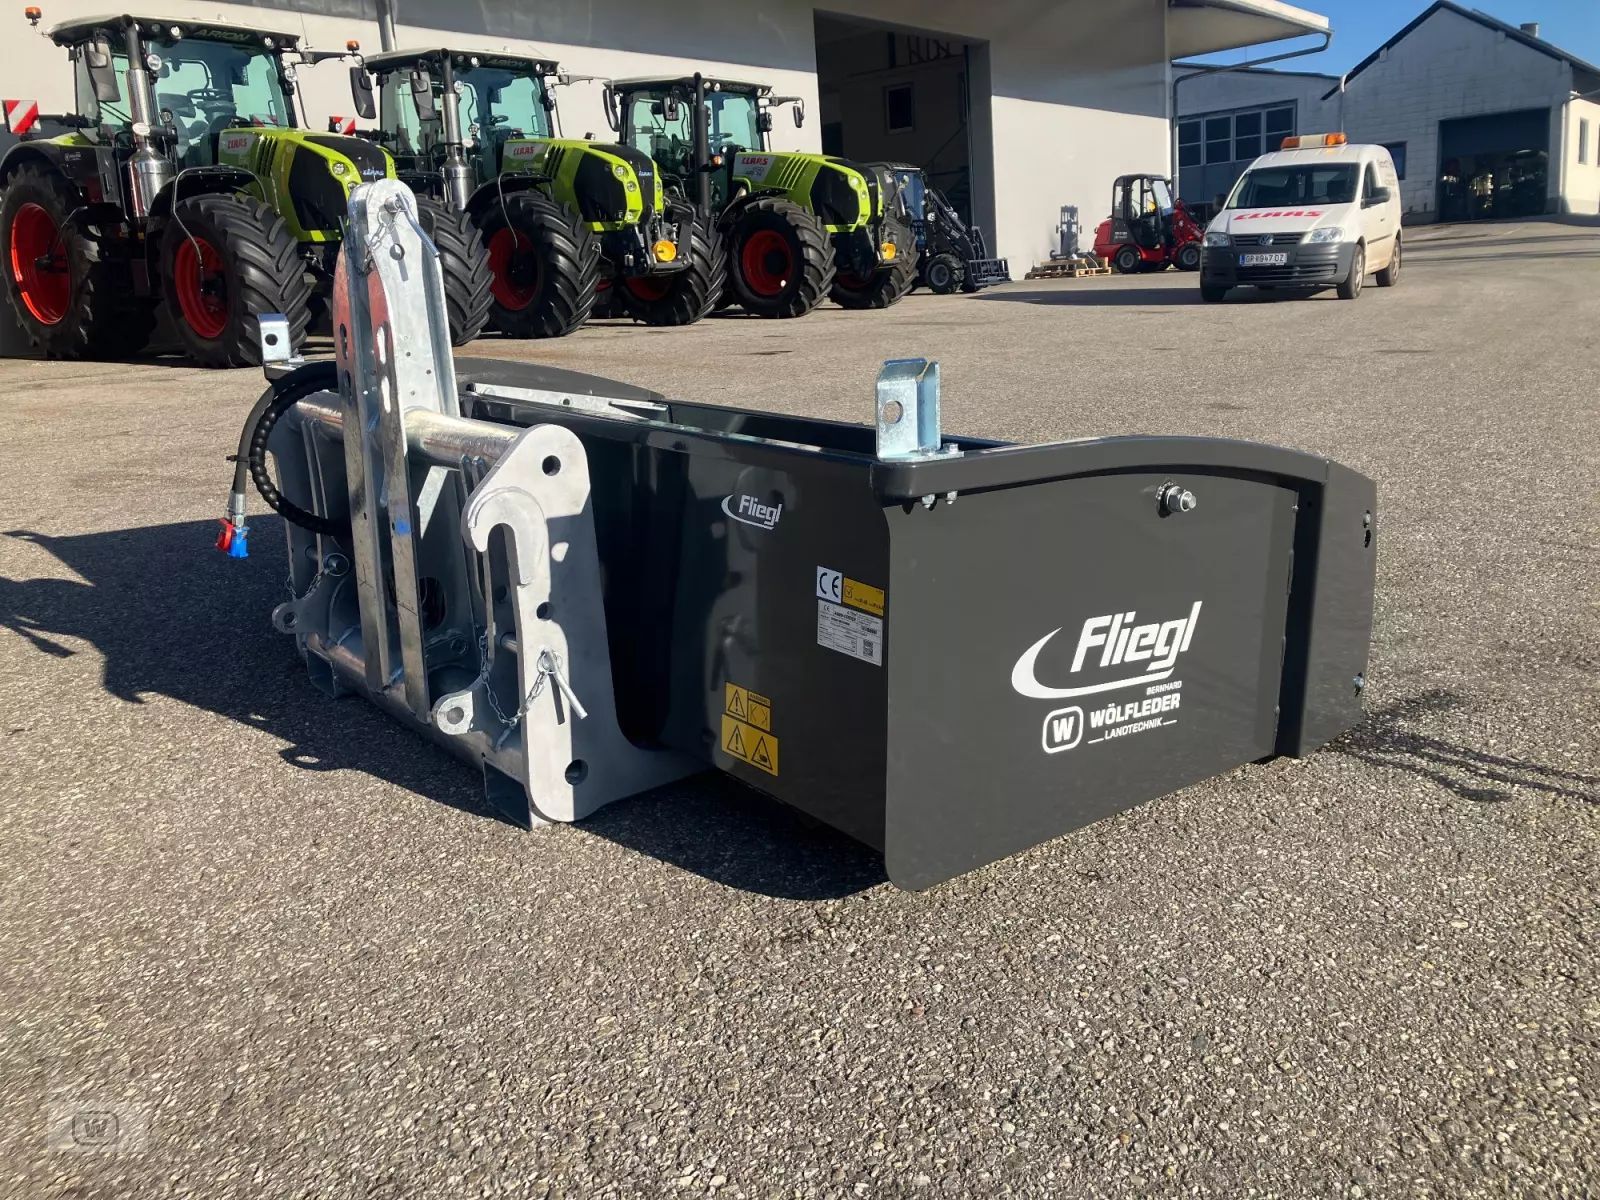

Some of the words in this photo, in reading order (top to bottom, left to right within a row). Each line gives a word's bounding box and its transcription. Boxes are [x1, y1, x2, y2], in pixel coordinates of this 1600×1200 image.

[193, 29, 252, 41] ARION
[742, 157, 769, 165] CLAAS
[1234, 211, 1325, 220] CLAAS
[738, 494, 783, 527] Fliegl
[1070, 600, 1203, 673] Fliegl
[1146, 680, 1183, 696] BERNHARD
[1053, 716, 1075, 743] W
[1090, 692, 1181, 728] WÖLFLEDER
[1105, 717, 1163, 740] LANDTECHNIK
